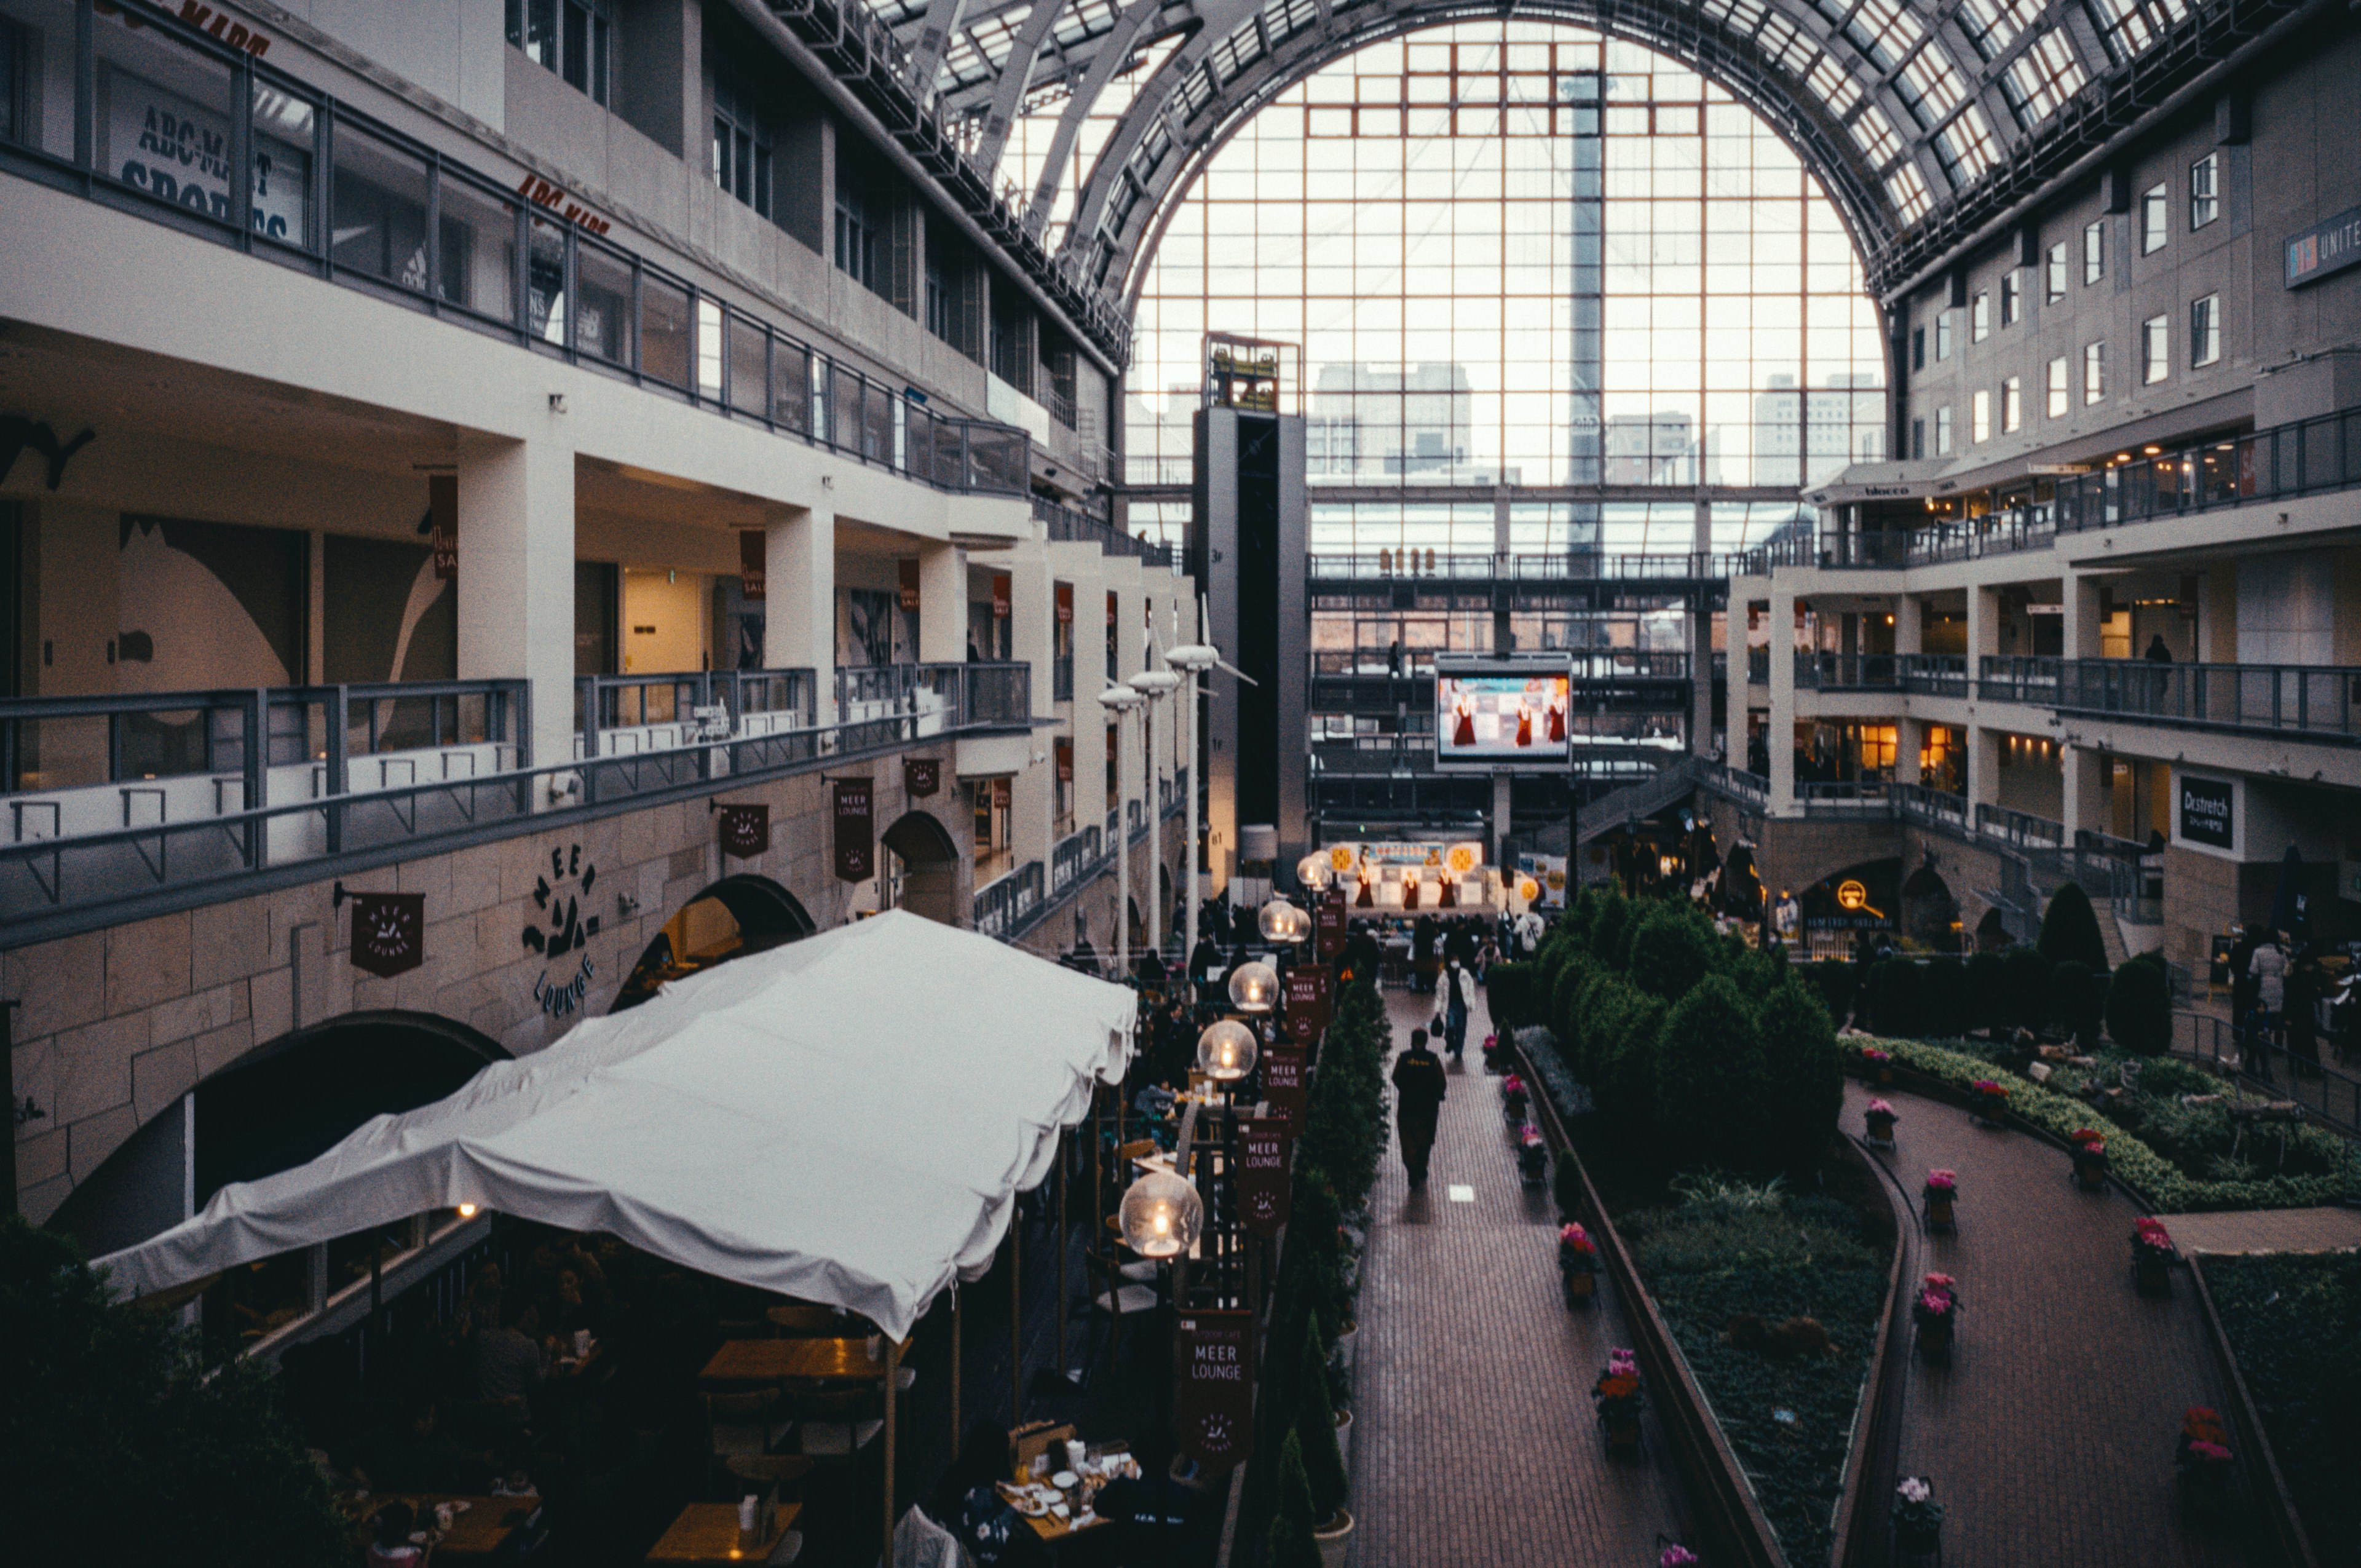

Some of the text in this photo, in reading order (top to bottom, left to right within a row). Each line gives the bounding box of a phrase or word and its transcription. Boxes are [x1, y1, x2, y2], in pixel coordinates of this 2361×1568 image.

[534, 953, 594, 1017] LOUNGE
[1271, 1064, 1296, 1075] MEER
[1268, 1076, 1299, 1087] LOUNGE
[1248, 1142, 1278, 1155] MEER
[1246, 1155, 1282, 1168] LOUNGE
[1195, 1344, 1237, 1361] MEER
[1192, 1364, 1241, 1380] LOUNGE
